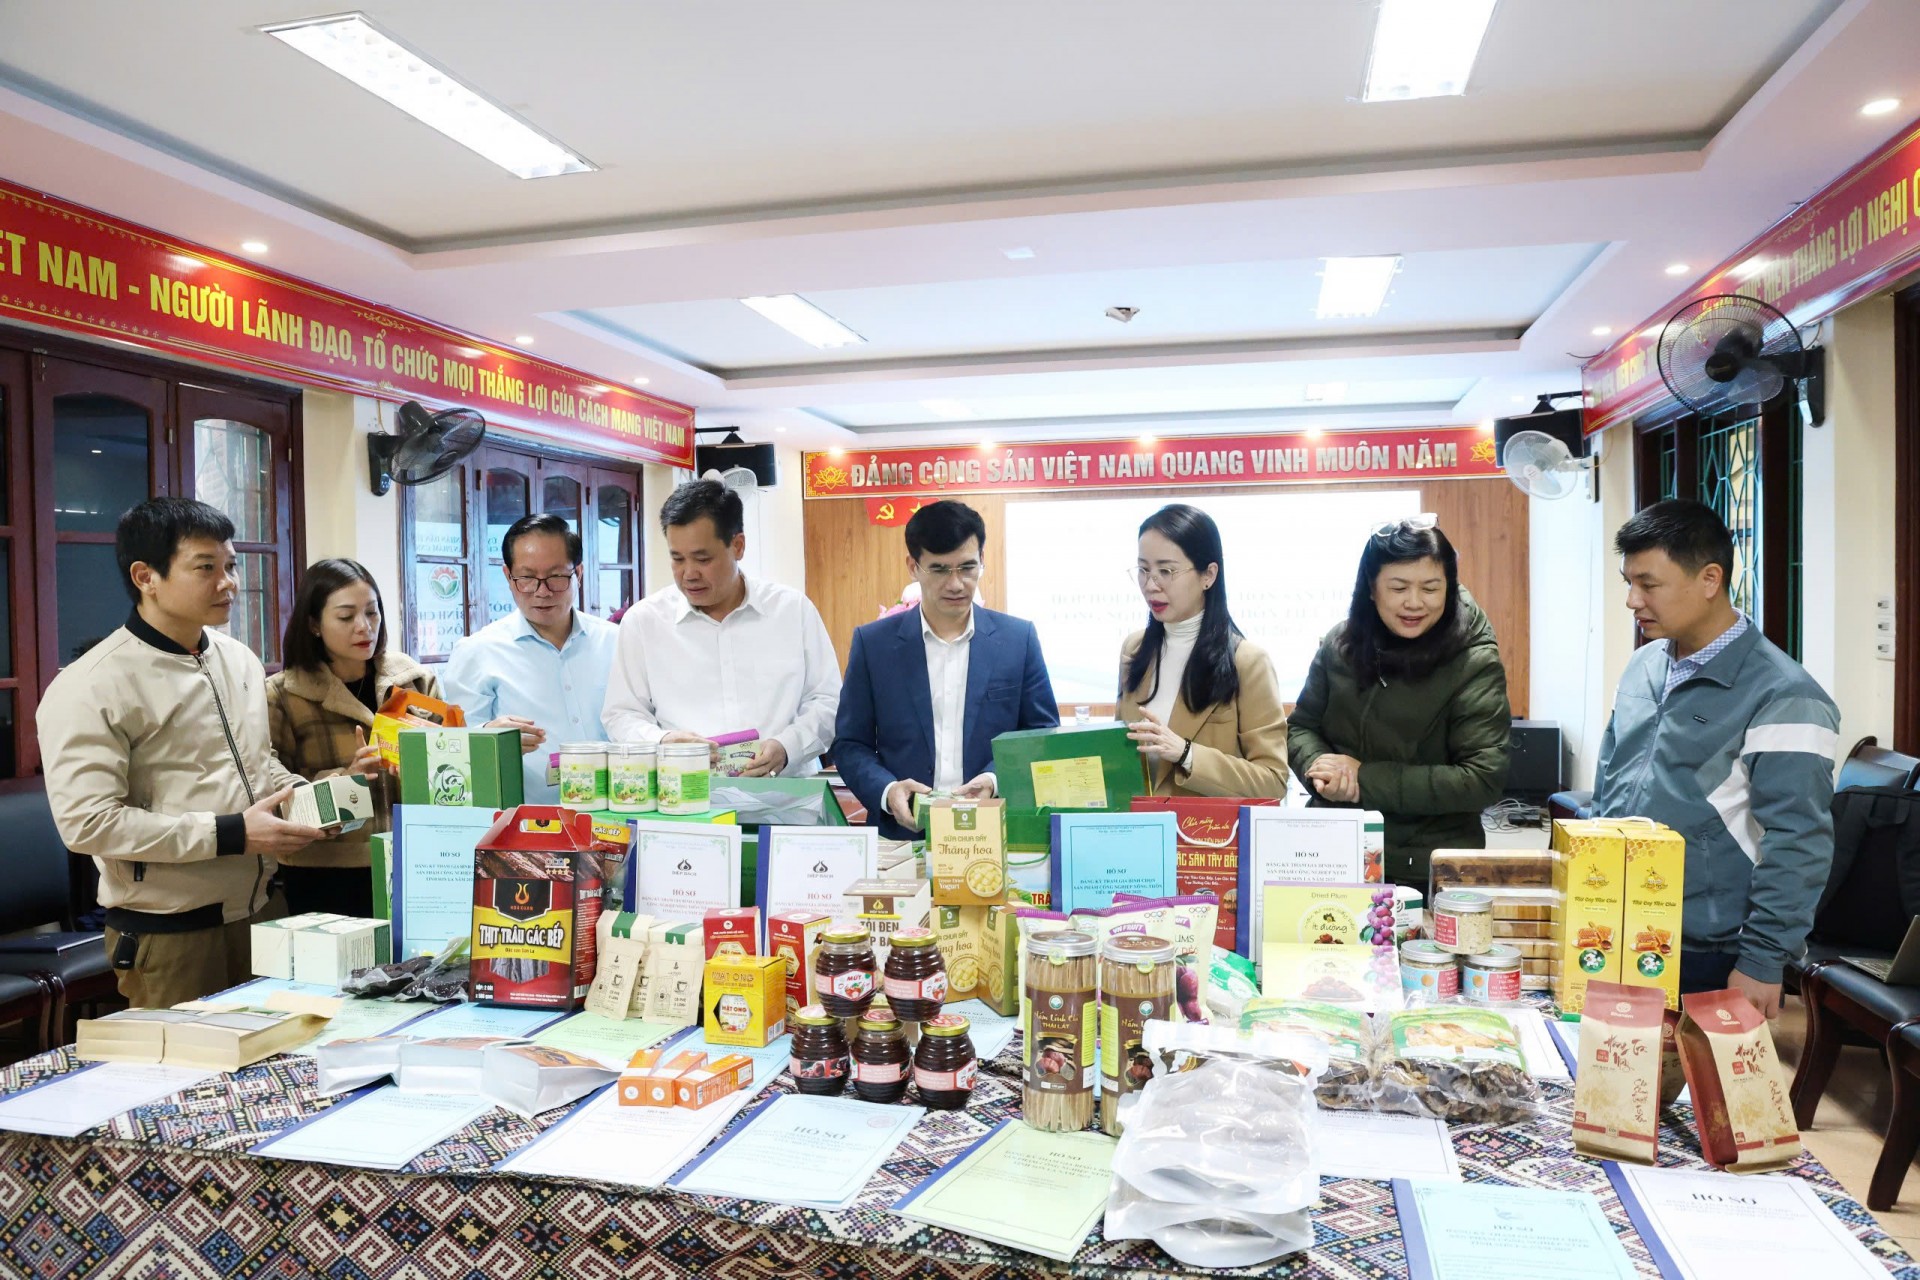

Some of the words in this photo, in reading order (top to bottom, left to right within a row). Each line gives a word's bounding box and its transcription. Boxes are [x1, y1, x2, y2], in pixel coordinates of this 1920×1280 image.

[1792, 223, 1836, 288] THẮNG
[1839, 205, 1863, 265] LỢI
[1867, 178, 1907, 246] NGHỊ
[39, 240, 117, 301] NAM
[150, 274, 234, 331] NGƯỜI
[242, 298, 303, 349] LÃNH
[309, 320, 357, 368] ĐẠO,
[363, 328, 387, 370] TỔ
[392, 344, 438, 383] CHỨC
[443, 358, 474, 397] MỌI
[478, 365, 525, 405] THẮNG
[528, 381, 548, 416] LỢI
[551, 384, 575, 420] CỦA
[578, 394, 609, 428] CÁCH
[611, 407, 641, 440] MẠNG
[643, 413, 663, 446] VIỆT
[665, 422, 685, 448] NAM
[851, 454, 912, 487] ĐẢNG
[918, 455, 980, 489] CỘNG
[986, 449, 1034, 483] SẢN
[1041, 451, 1091, 484] VIỆT
[1098, 453, 1154, 479] NAM
[1162, 450, 1244, 479] QUANG
[1250, 448, 1308, 474] VINH
[1316, 440, 1390, 472] MUÔN
[1397, 438, 1458, 469] NĂM
[973, 844, 992, 855] hoa
[1207, 852, 1223, 867] TÂY
[479, 924, 500, 948] THỊT
[500, 925, 525, 944] TRÂU
[526, 926, 546, 946] GÁC
[547, 921, 564, 949] BẾP
[879, 922, 899, 933] ĐEN
[956, 941, 972, 951] hoa
